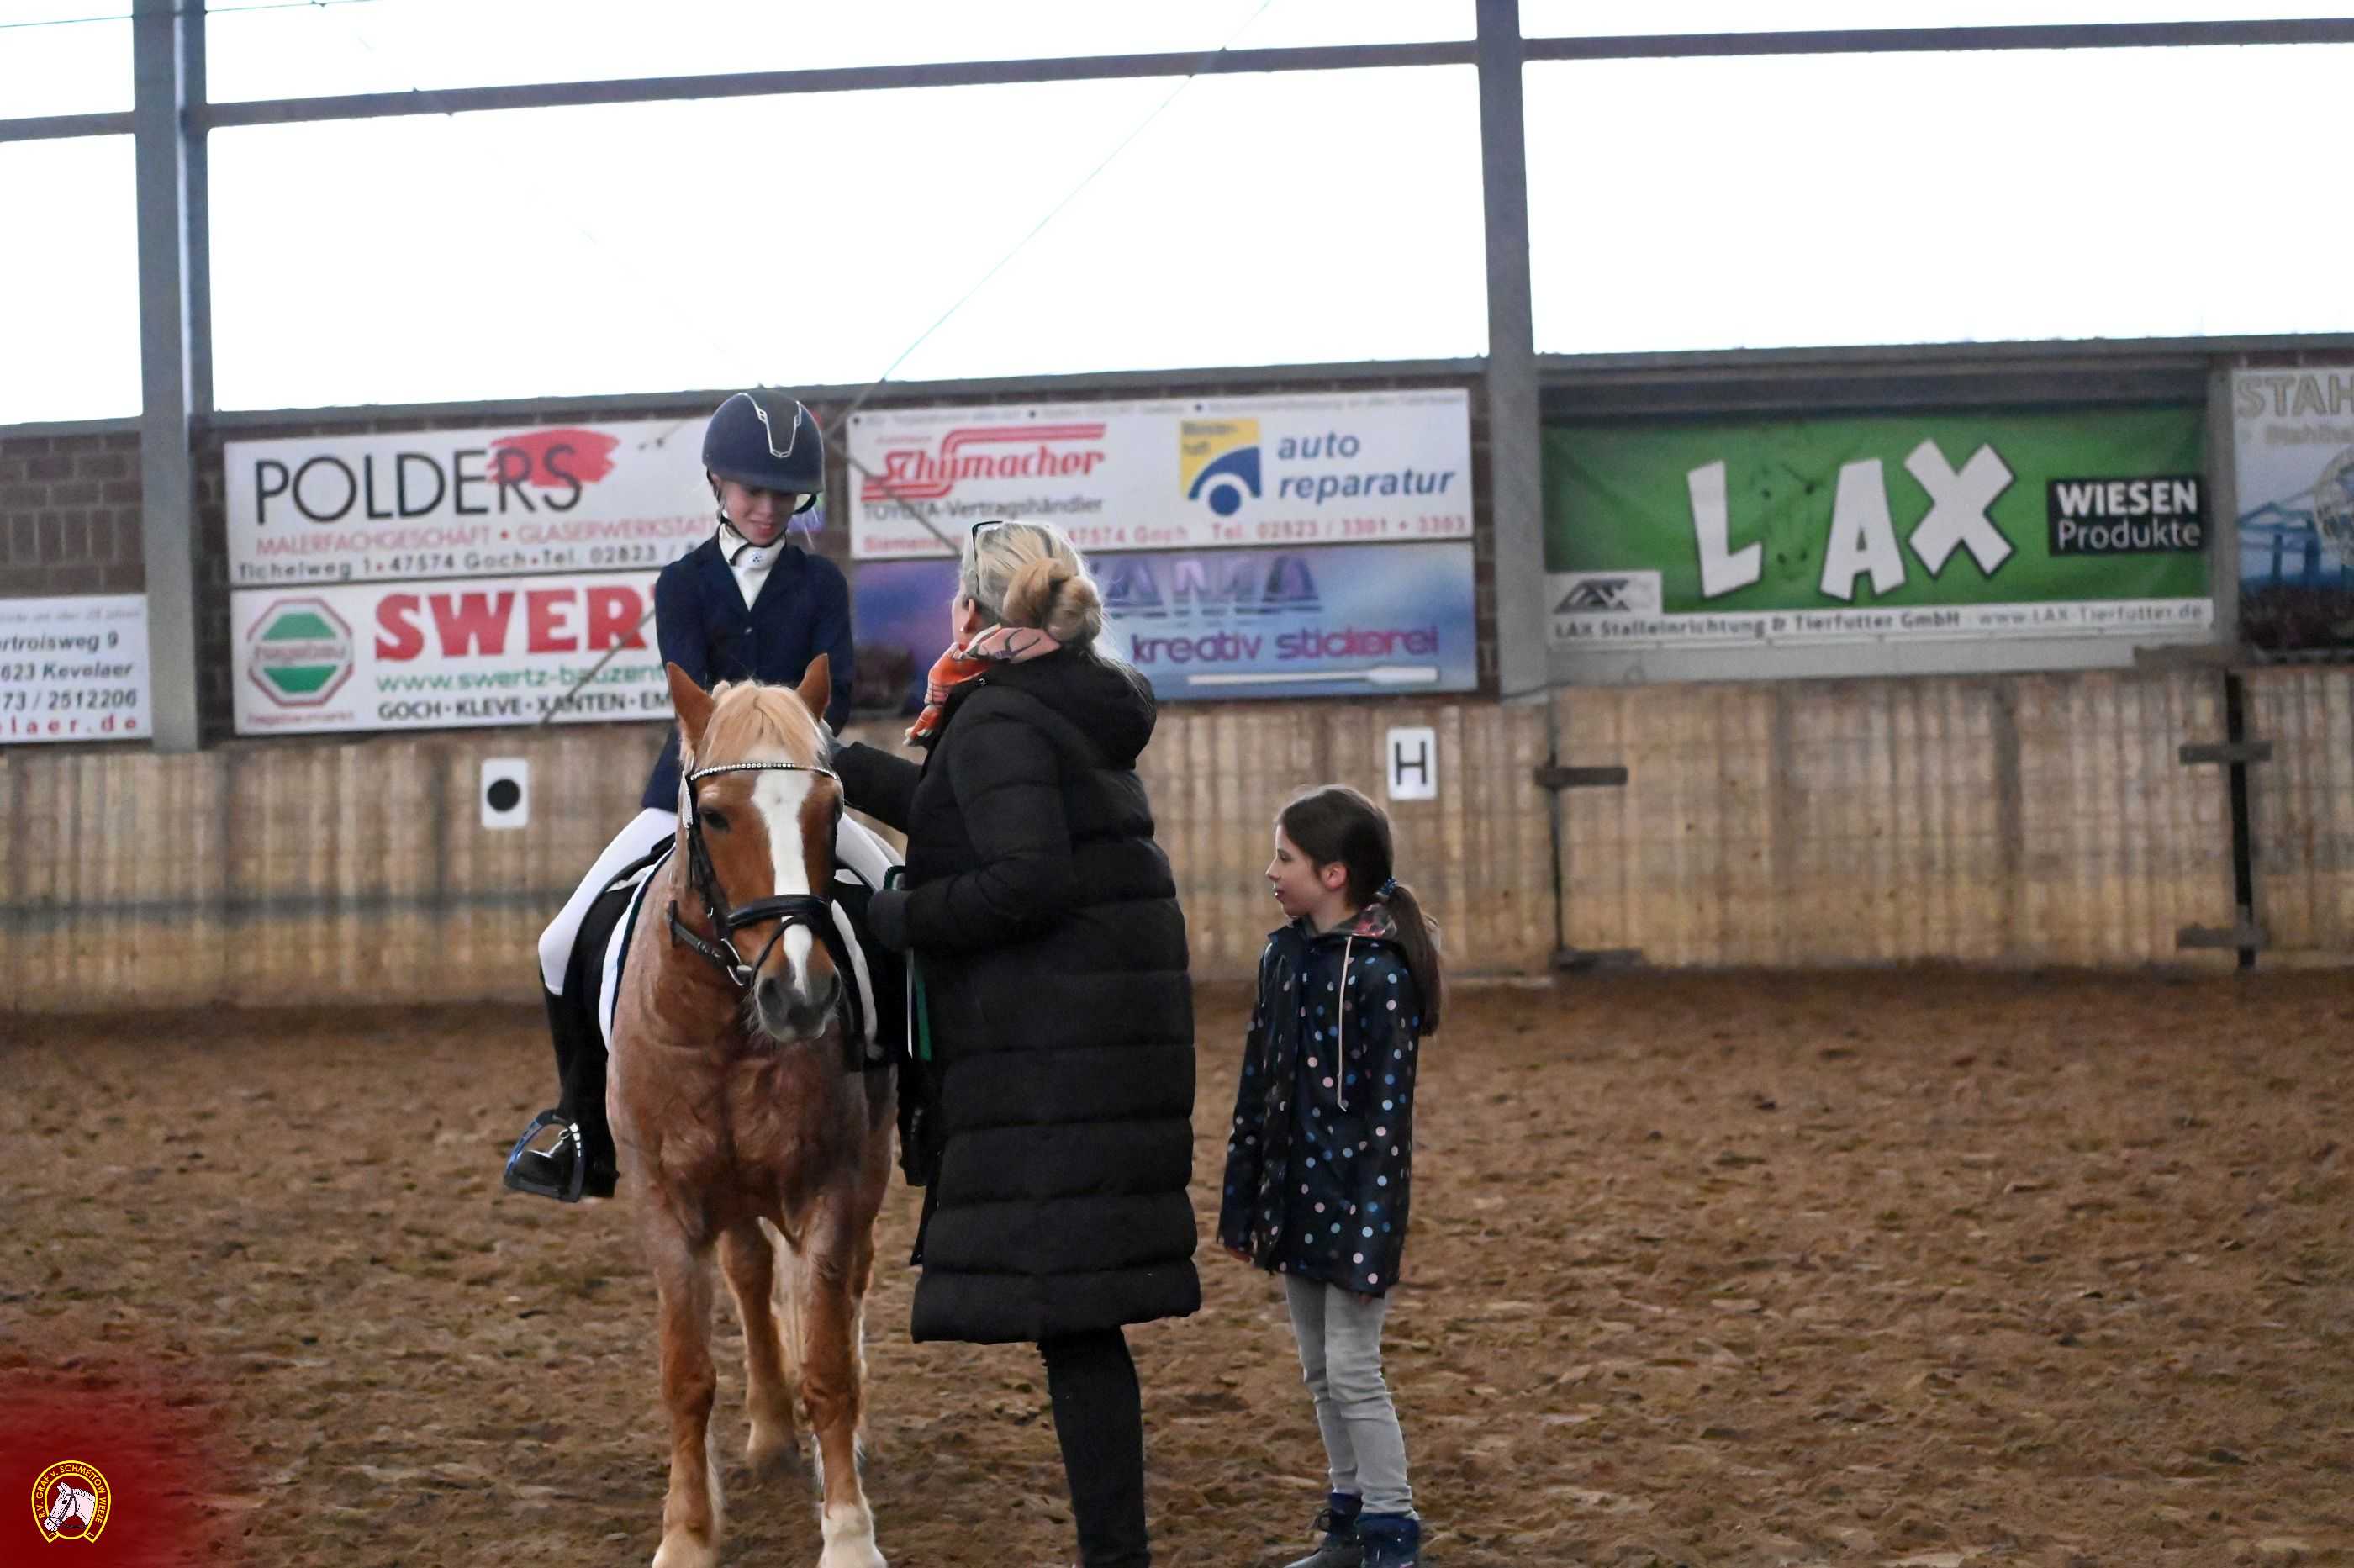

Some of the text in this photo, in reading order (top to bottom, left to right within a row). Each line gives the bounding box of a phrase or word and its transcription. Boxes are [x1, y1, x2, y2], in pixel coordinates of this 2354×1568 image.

[1276, 430, 1362, 461] auto
[255, 443, 583, 525] POLDERS
[1278, 467, 1457, 507] reparatur
[2056, 479, 2198, 517] WIESEN
[1686, 436, 2016, 603] LAX
[2057, 516, 2202, 551] Produkte
[389, 553, 455, 573] 47574
[463, 546, 526, 570] Goch
[375, 584, 657, 662] SWER
[1899, 610, 1961, 629] GmbH
[0, 631, 100, 653] rtroisweg
[1129, 628, 1264, 665] kreativ
[1275, 624, 1441, 661] stickerei
[42, 660, 134, 679] Kevelaer
[377, 698, 441, 720] GOCH
[455, 695, 521, 717] KLEVE
[1394, 740, 1428, 787] H
